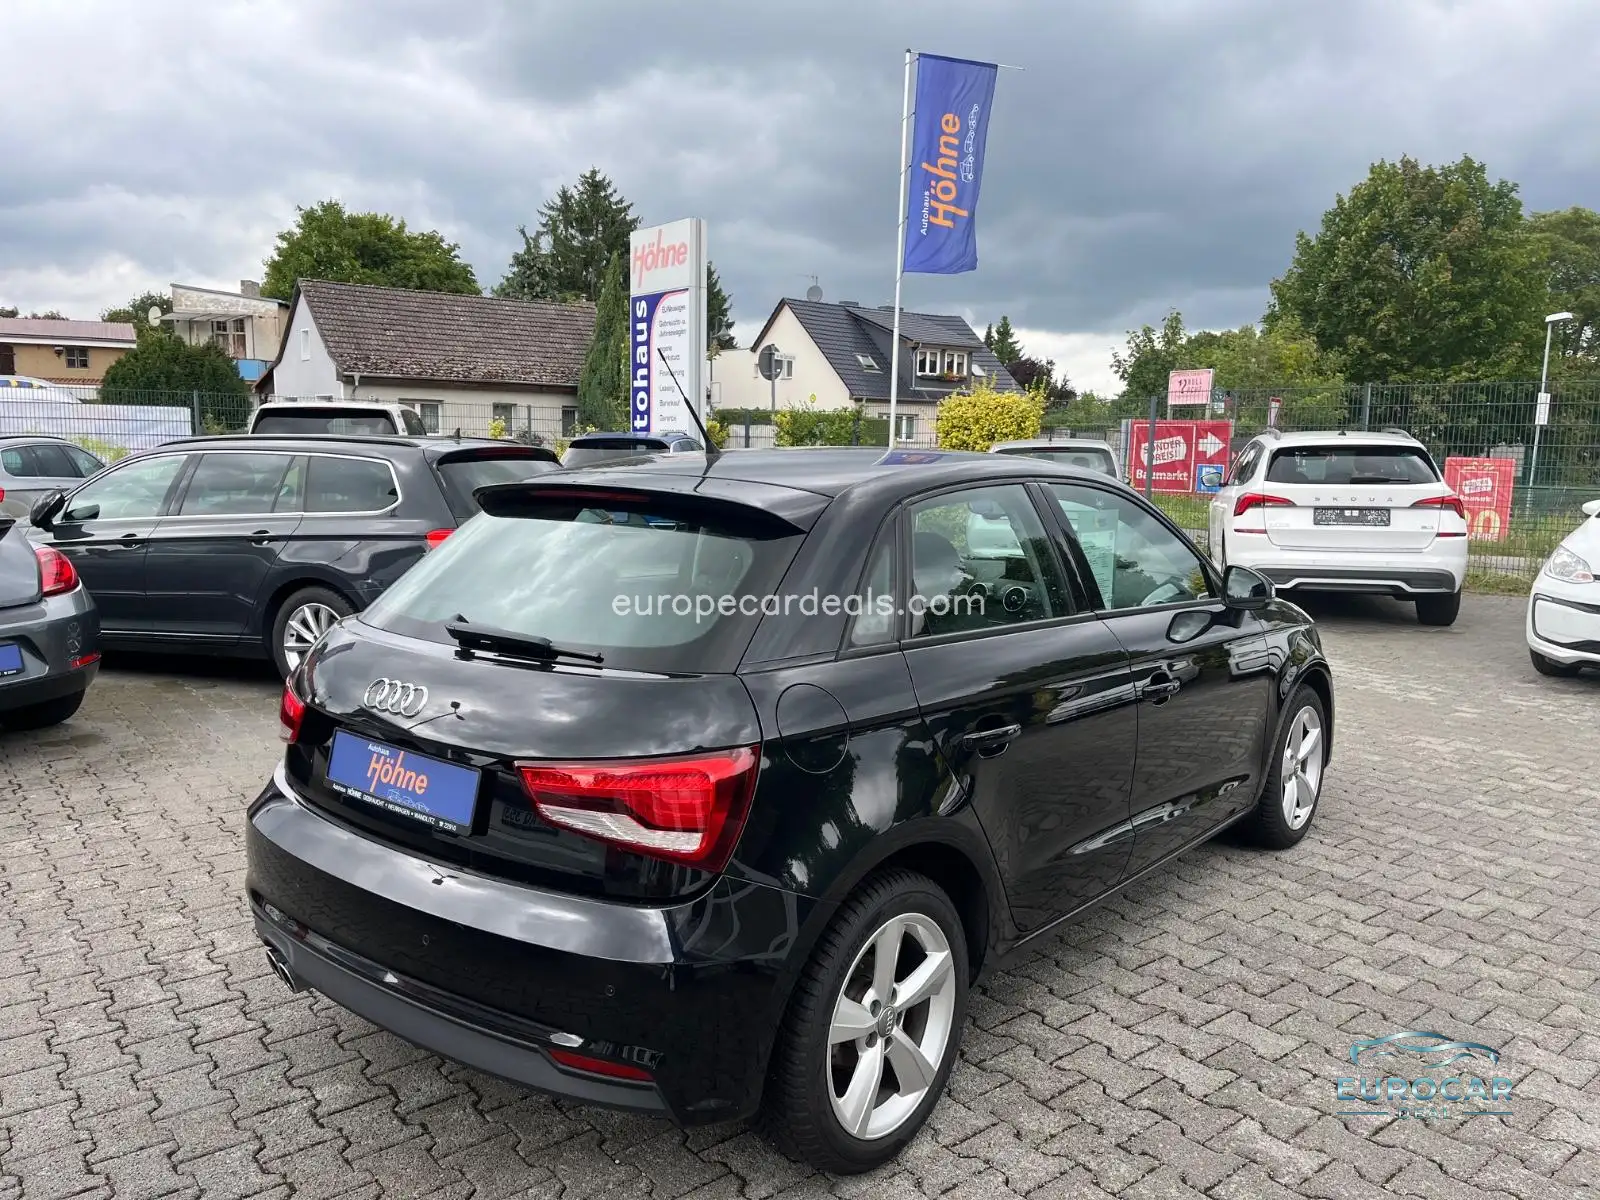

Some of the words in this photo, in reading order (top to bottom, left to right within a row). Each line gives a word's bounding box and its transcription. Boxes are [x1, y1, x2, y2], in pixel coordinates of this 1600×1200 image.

[922, 113, 968, 228] Höhne
[920, 190, 930, 235] Autohaus
[632, 228, 688, 288] Höhne
[633, 300, 648, 430] tohaus
[659, 369, 685, 377] Finanierung
[1144, 439, 1181, 456] SNDER
[1151, 449, 1178, 463] REIS!
[367, 743, 390, 756] Autohaus
[367, 751, 428, 795] Höhne
